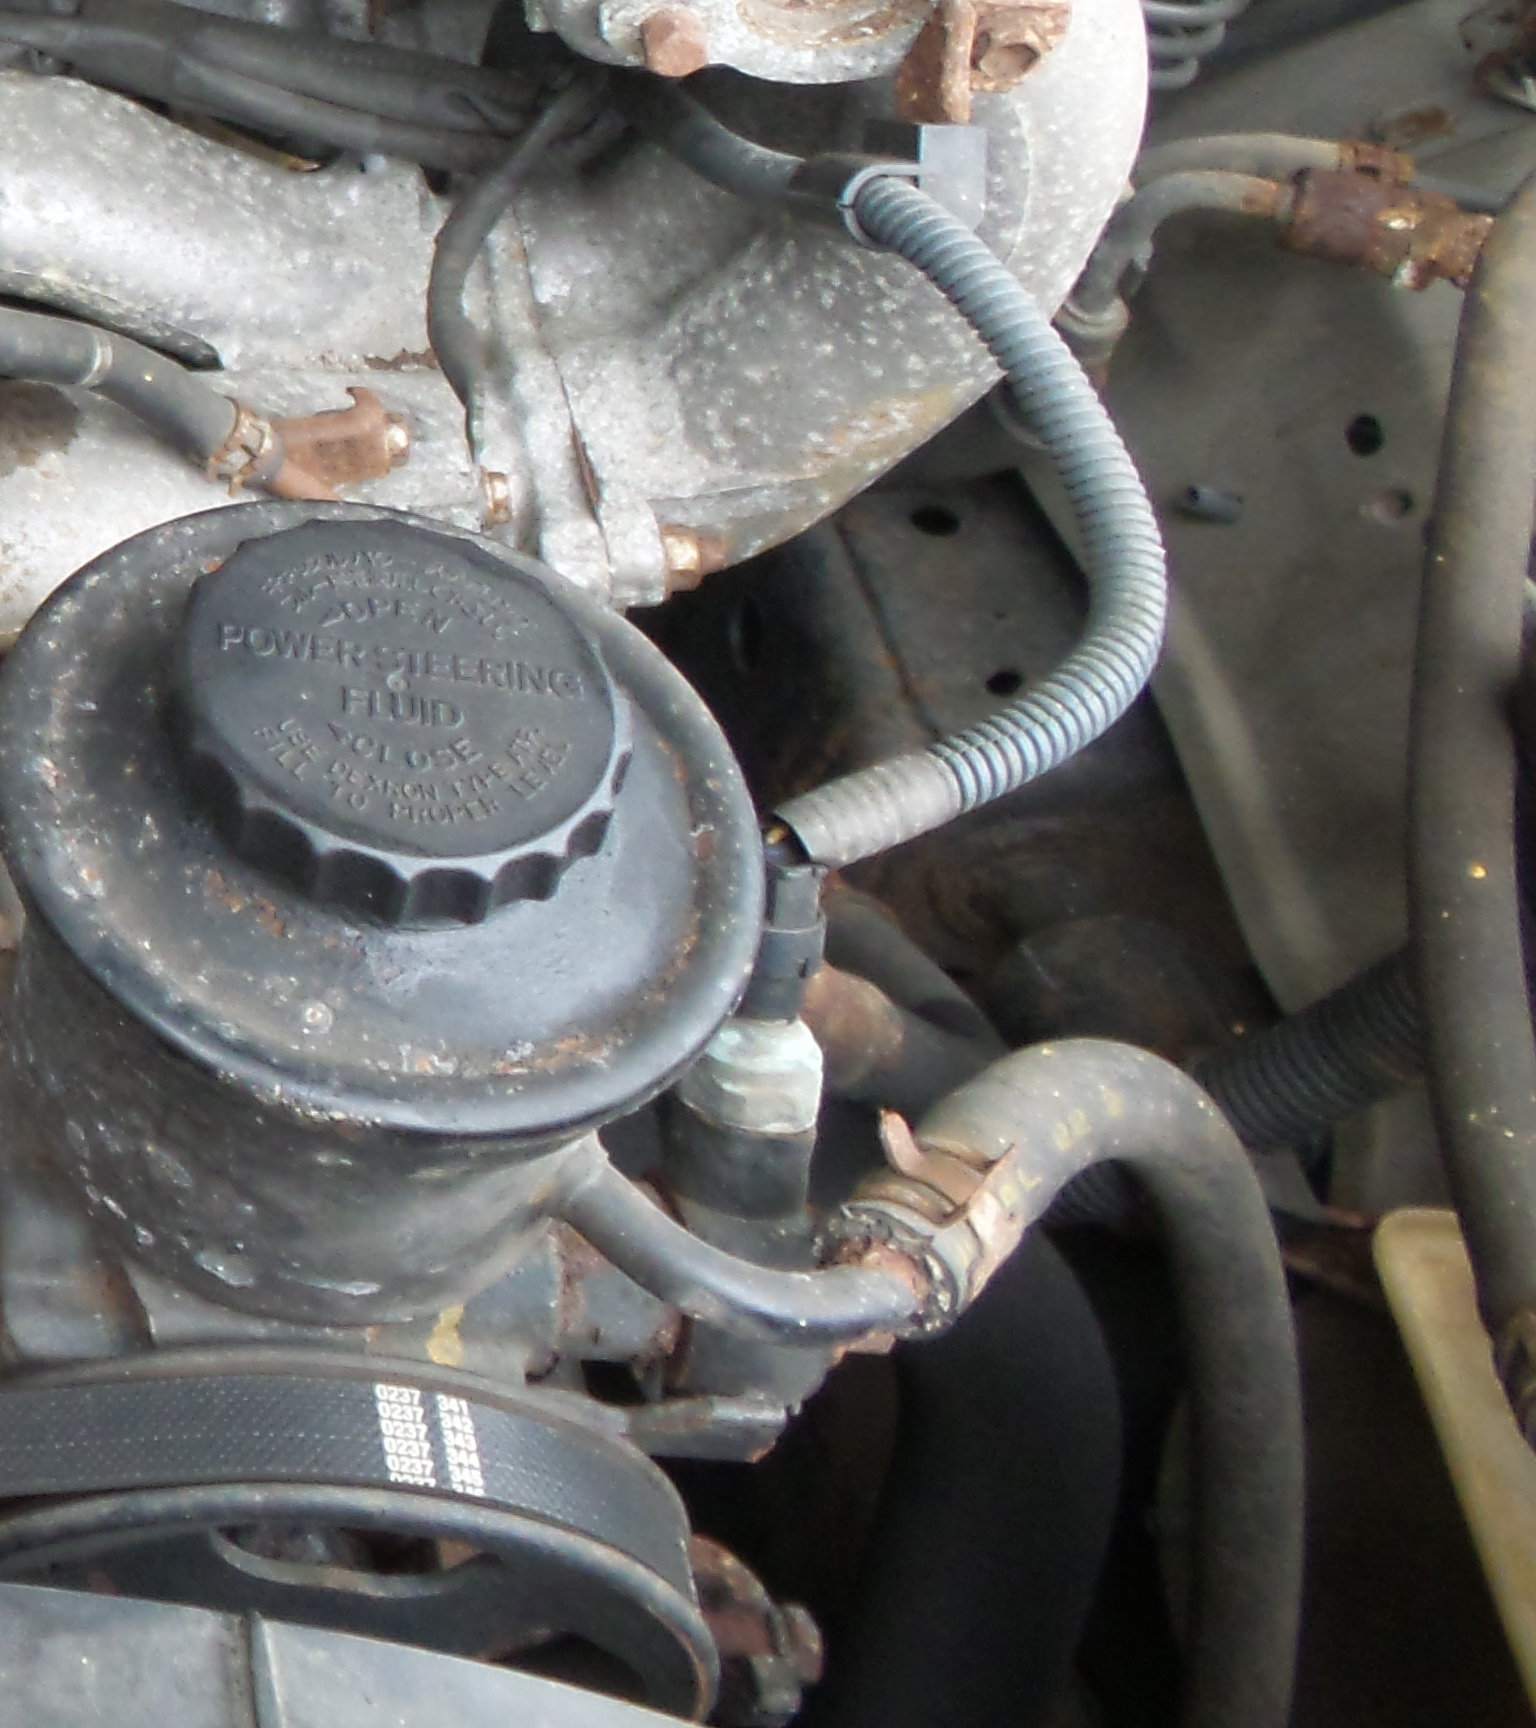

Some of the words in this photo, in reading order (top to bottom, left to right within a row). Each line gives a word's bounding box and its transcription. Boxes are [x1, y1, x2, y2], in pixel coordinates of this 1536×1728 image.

[218, 623, 365, 669] POWER
[376, 644, 585, 700] STEERING
[341, 685, 466, 729] FLUID
[375, 1384, 421, 1405] 0237
[378, 1401, 424, 1424] 0237
[381, 1418, 428, 1441] 0237
[384, 1436, 431, 1459] 0237
[387, 1454, 434, 1476] 0237
